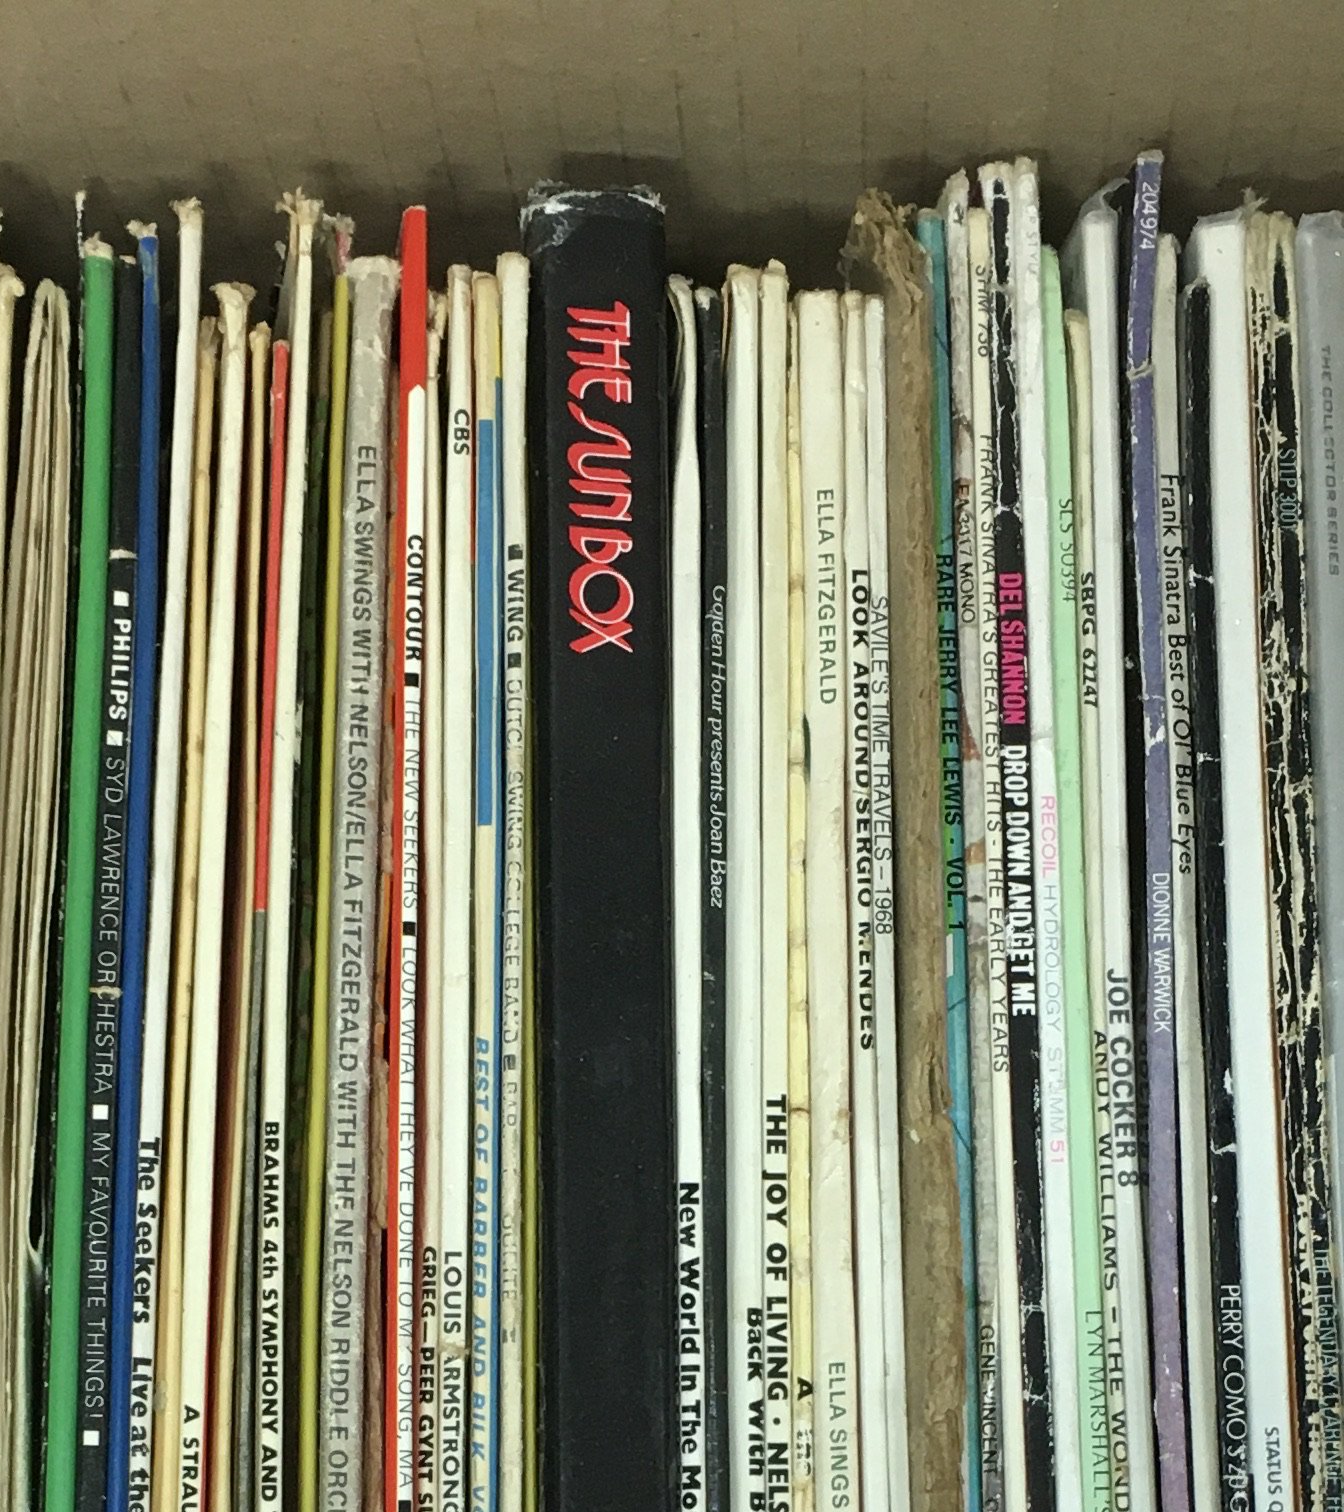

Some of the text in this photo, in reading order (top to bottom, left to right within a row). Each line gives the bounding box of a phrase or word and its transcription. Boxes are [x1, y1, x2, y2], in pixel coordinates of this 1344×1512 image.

[453, 409, 470, 455] CBS
[565, 301, 634, 653] THE SUN BOX
[406, 534, 424, 660] CONTOUR
[506, 568, 525, 643] WING
[815, 488, 838, 704] ELLA FITZGERALD
[109, 618, 131, 720] PHILIPS
[1160, 474, 1196, 875] Frank Sinatra Best of Ol' Blue Eyes
[999, 572, 1036, 1016] DEL SHANNON DROP DOWN AND GET ME
[91, 757, 125, 1094] SYD LAWRENCE ORCHESTRA
[1152, 873, 1172, 943] DIONNE
[1153, 949, 1172, 1032] WARWICK
[1107, 968, 1139, 1187] JOE COCKER 8
[765, 1095, 786, 1154] THE
[262, 1121, 279, 1229] BRAHMS
[678, 1183, 699, 1249] New
[762, 1171, 786, 1227] JOY
[83, 1131, 112, 1420] MY FAVOURITE THINGS!
[262, 1239, 279, 1280] 4th
[767, 1242, 787, 1282] OF
[680, 1258, 700, 1353] World
[260, 1288, 279, 1434] SYMPHONY
[680, 1365, 699, 1393] In
[767, 1296, 788, 1401] LIVING
[184, 1405, 200, 1423] A
[680, 1402, 702, 1454] The
[261, 1445, 278, 1502] AND
[1265, 1427, 1285, 1493] STATUS
